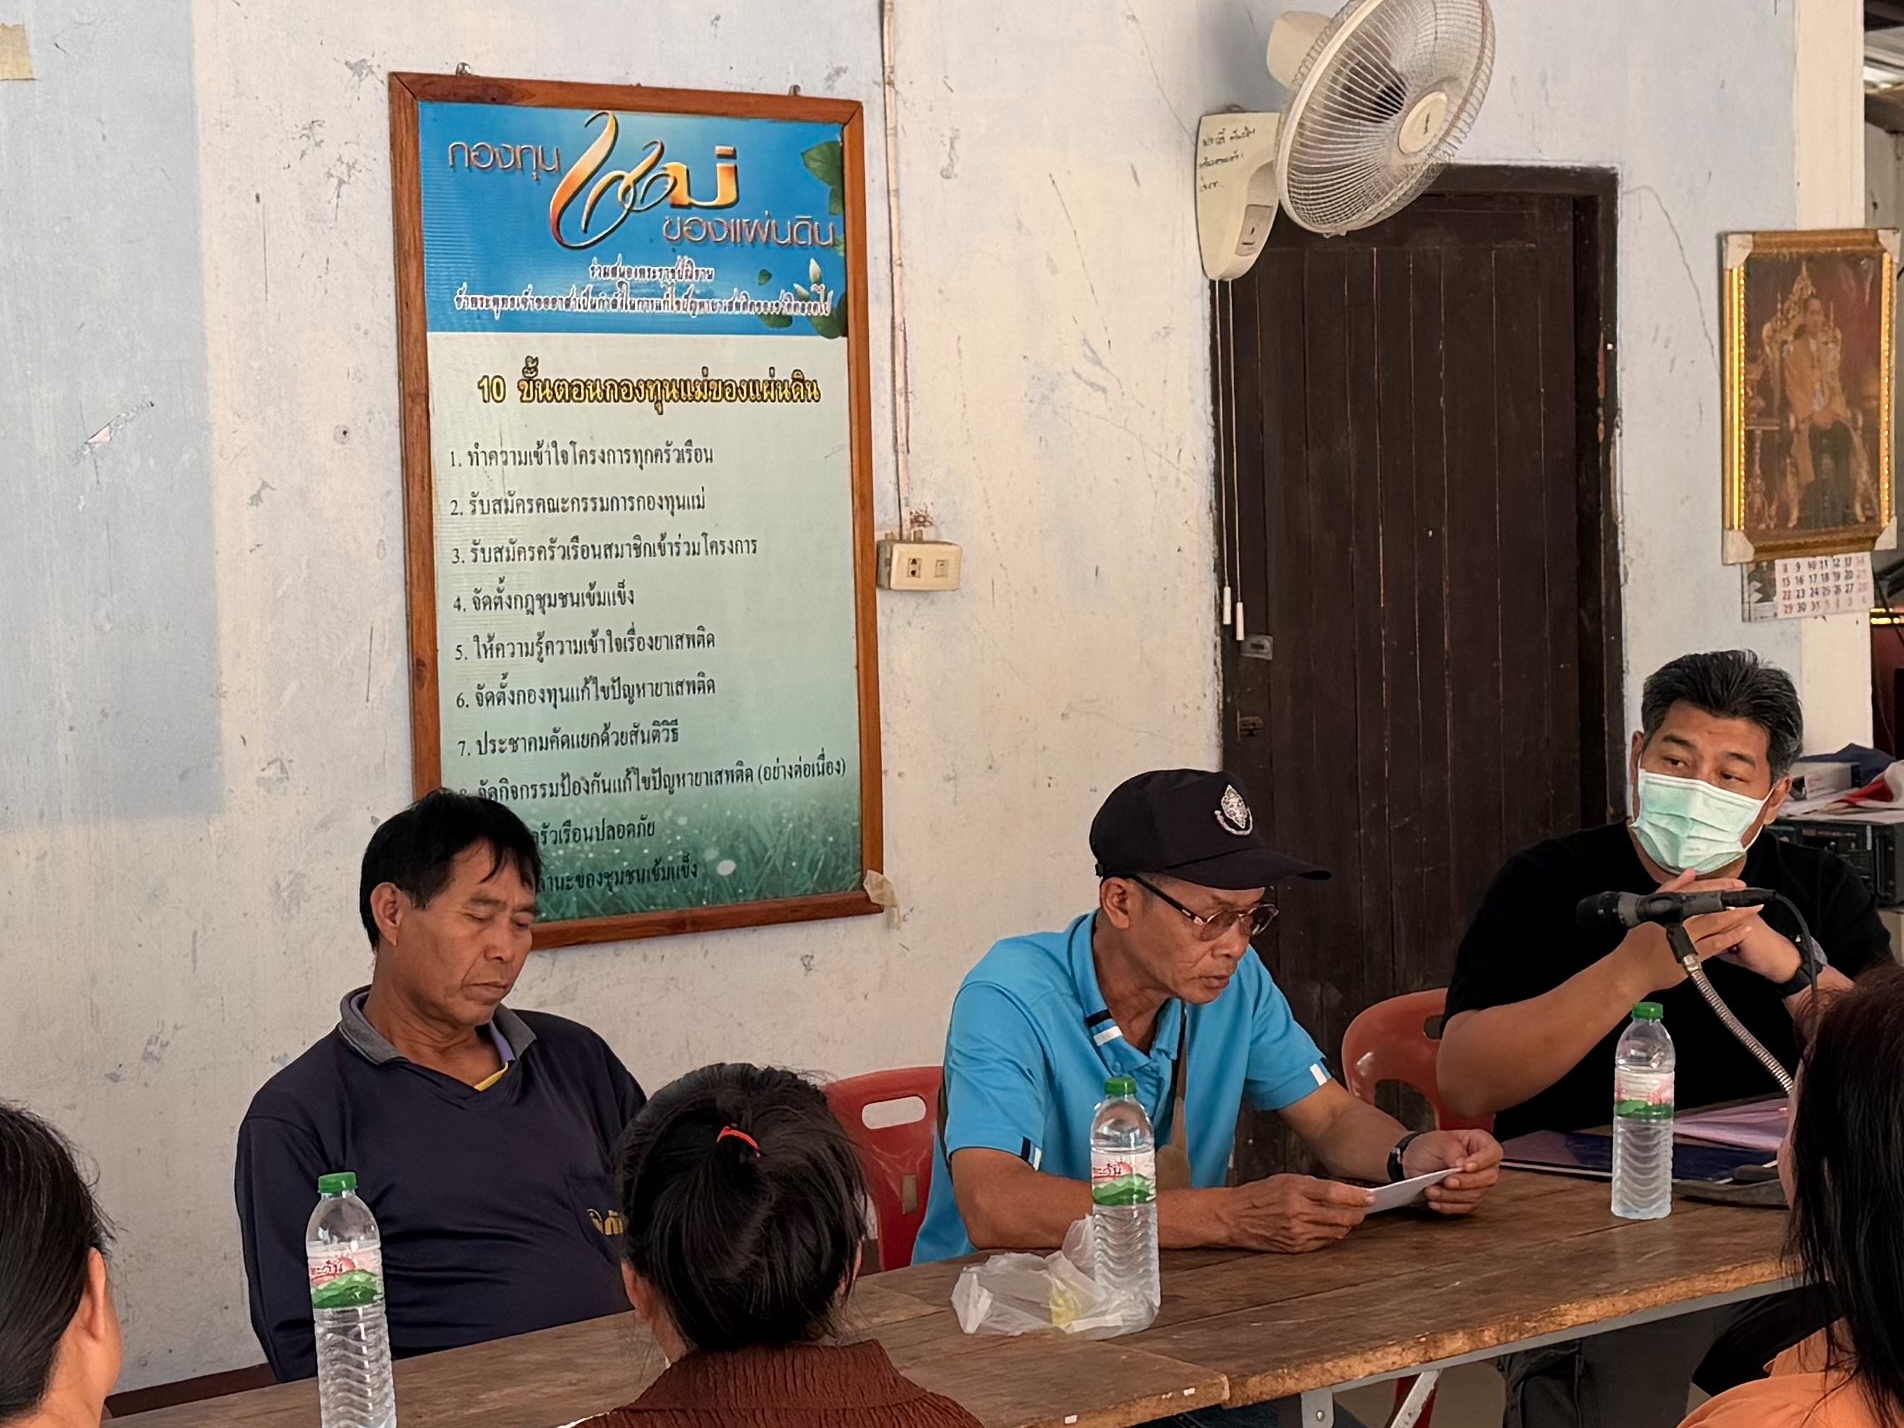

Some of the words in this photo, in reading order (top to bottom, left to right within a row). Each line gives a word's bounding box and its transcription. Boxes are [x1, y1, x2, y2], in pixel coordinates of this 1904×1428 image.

[448, 141, 562, 181] กองทุน
[550, 110, 739, 250] แม่
[662, 210, 836, 248] ของแผ่นดิน
[478, 374, 507, 403] 10
[517, 355, 822, 415] ขั้นตอนกองทุนแม่ของแผ่นดิน
[450, 450, 463, 468] 1.
[467, 439, 714, 471] ทำความเข้าใจโครงการทุกครัวเรือน
[450, 499, 464, 516] 2.
[469, 487, 706, 516] รับสมัครคณะกรรมการกองทุนแม่
[451, 547, 466, 565] 3.
[470, 532, 758, 563] รับสมัครครัวเรือนสมาชิกเข้าร่วมโครงการ
[452, 595, 467, 613] 4.
[454, 644, 469, 661] 5.
[473, 621, 716, 664] ให้ความรู้ความเข้าใจเรื่องยาเสพติด
[456, 691, 470, 709] 6.
[475, 670, 717, 710] จัดตั้งกองทุนแก้ไขปัญหายาเสพติด
[457, 739, 471, 757] 7.
[476, 718, 680, 756] ประชาคมคัดแยกด้วยสันติวิธี
[757, 747, 847, 785] (อย่างต่อเนื่อง)
